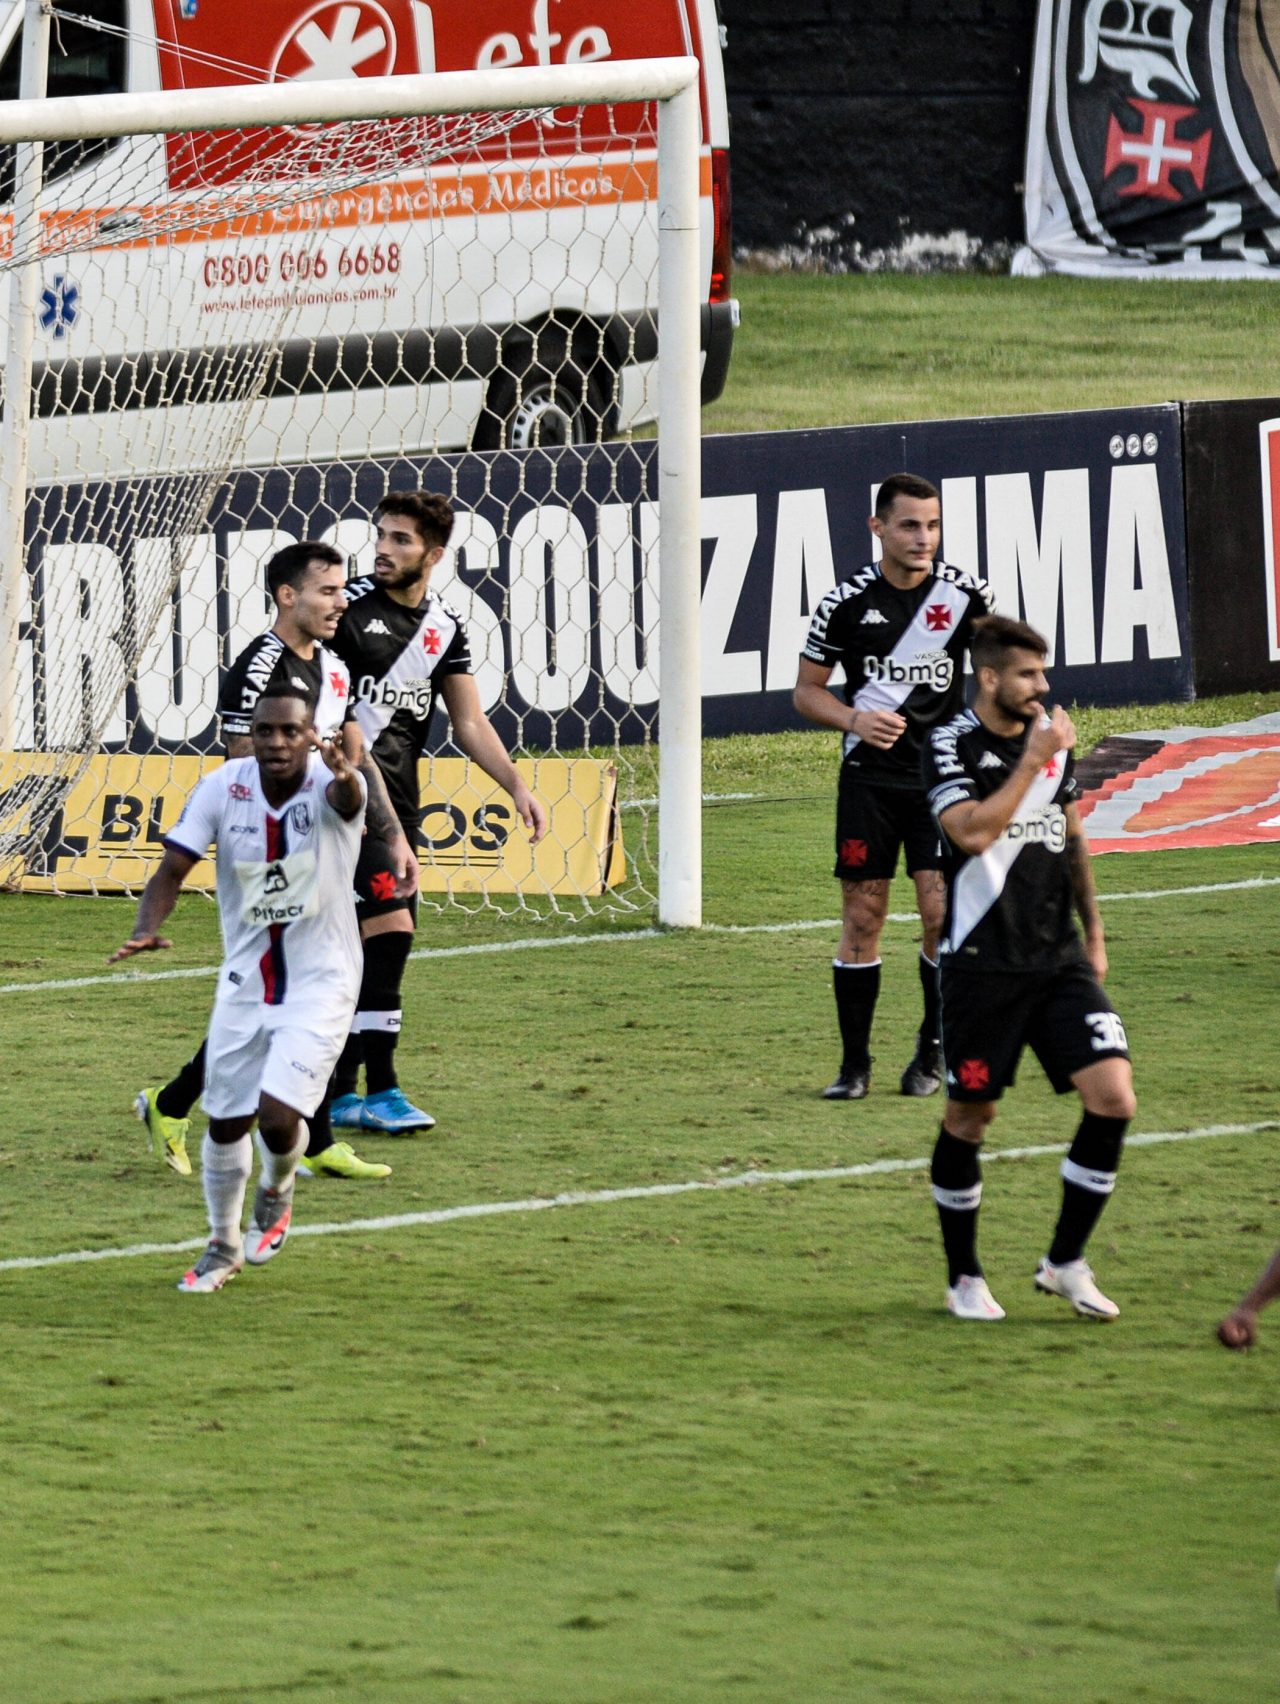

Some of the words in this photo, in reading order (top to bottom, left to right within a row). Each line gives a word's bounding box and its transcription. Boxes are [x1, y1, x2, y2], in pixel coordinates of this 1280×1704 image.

[486, 168, 613, 208] Médicas
[204, 253, 270, 288] 0800
[280, 250, 328, 281] 006
[338, 243, 401, 276] 6668
[810, 566, 877, 641] HAVAN
[887, 658, 954, 692] bmg
[914, 650, 948, 660] VASCO
[381, 680, 432, 721] bmg
[101, 794, 511, 851] BLOS
